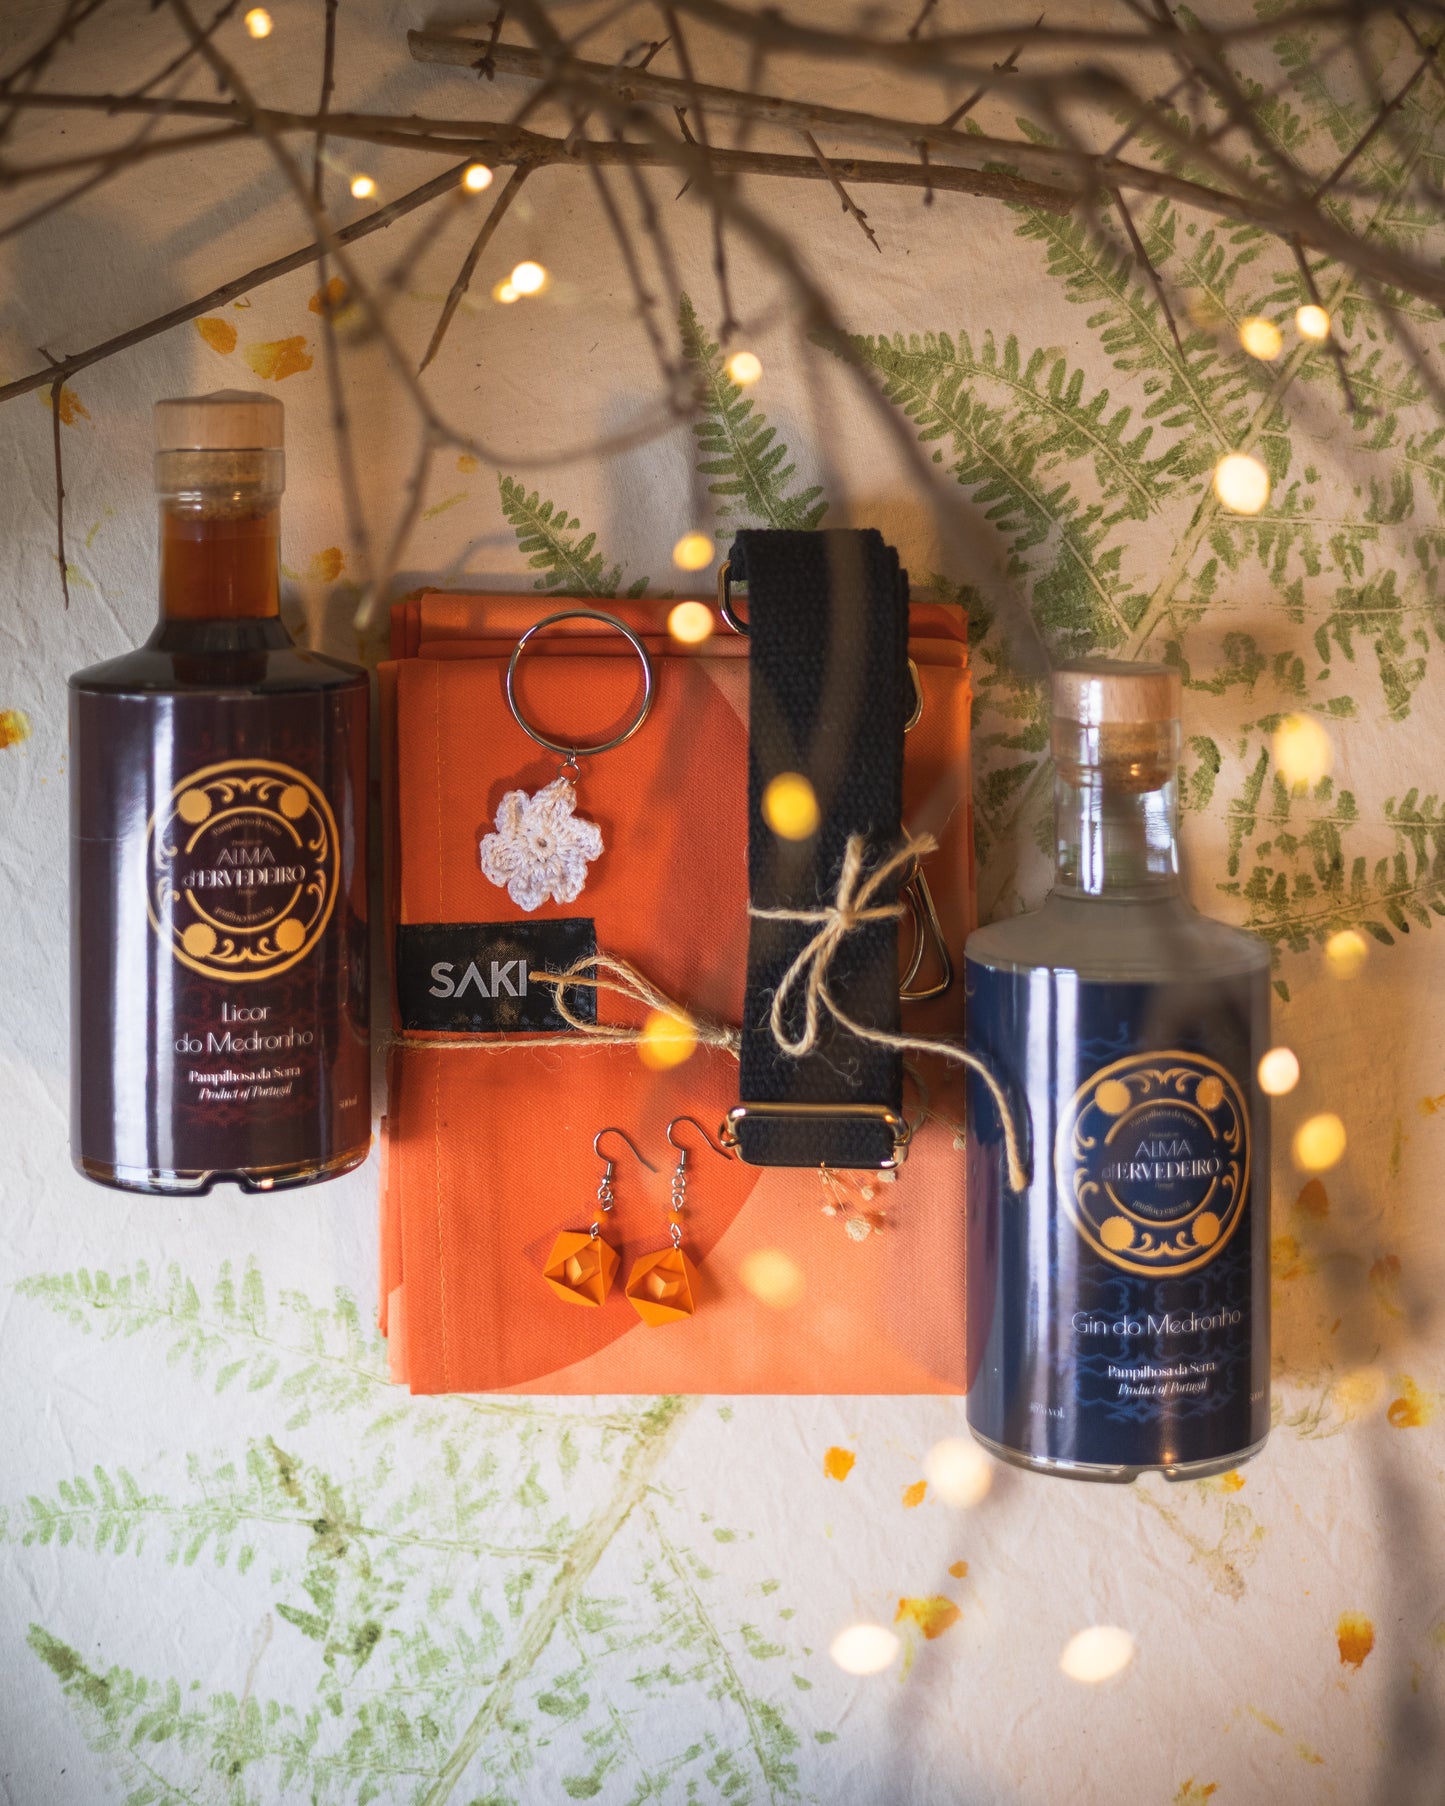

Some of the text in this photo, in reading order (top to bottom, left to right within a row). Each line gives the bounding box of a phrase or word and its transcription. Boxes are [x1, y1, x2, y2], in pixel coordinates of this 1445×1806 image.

[216, 847, 276, 865] ALMA
[183, 865, 306, 888] d'ERVEDEIRO
[429, 959, 527, 998] SAKI
[222, 1001, 271, 1023] Licor
[175, 1027, 314, 1053] do Medronho
[189, 1066, 301, 1086] Pampilhosa da Serra
[199, 1082, 293, 1100] Product of Portugal
[1135, 1139, 1192, 1157] ALMA
[1071, 1306, 1241, 1336] Gin do Medronho
[1108, 1361, 1216, 1381] Pampilhosa da Serra
[1118, 1378, 1208, 1397] Product of Portugal
